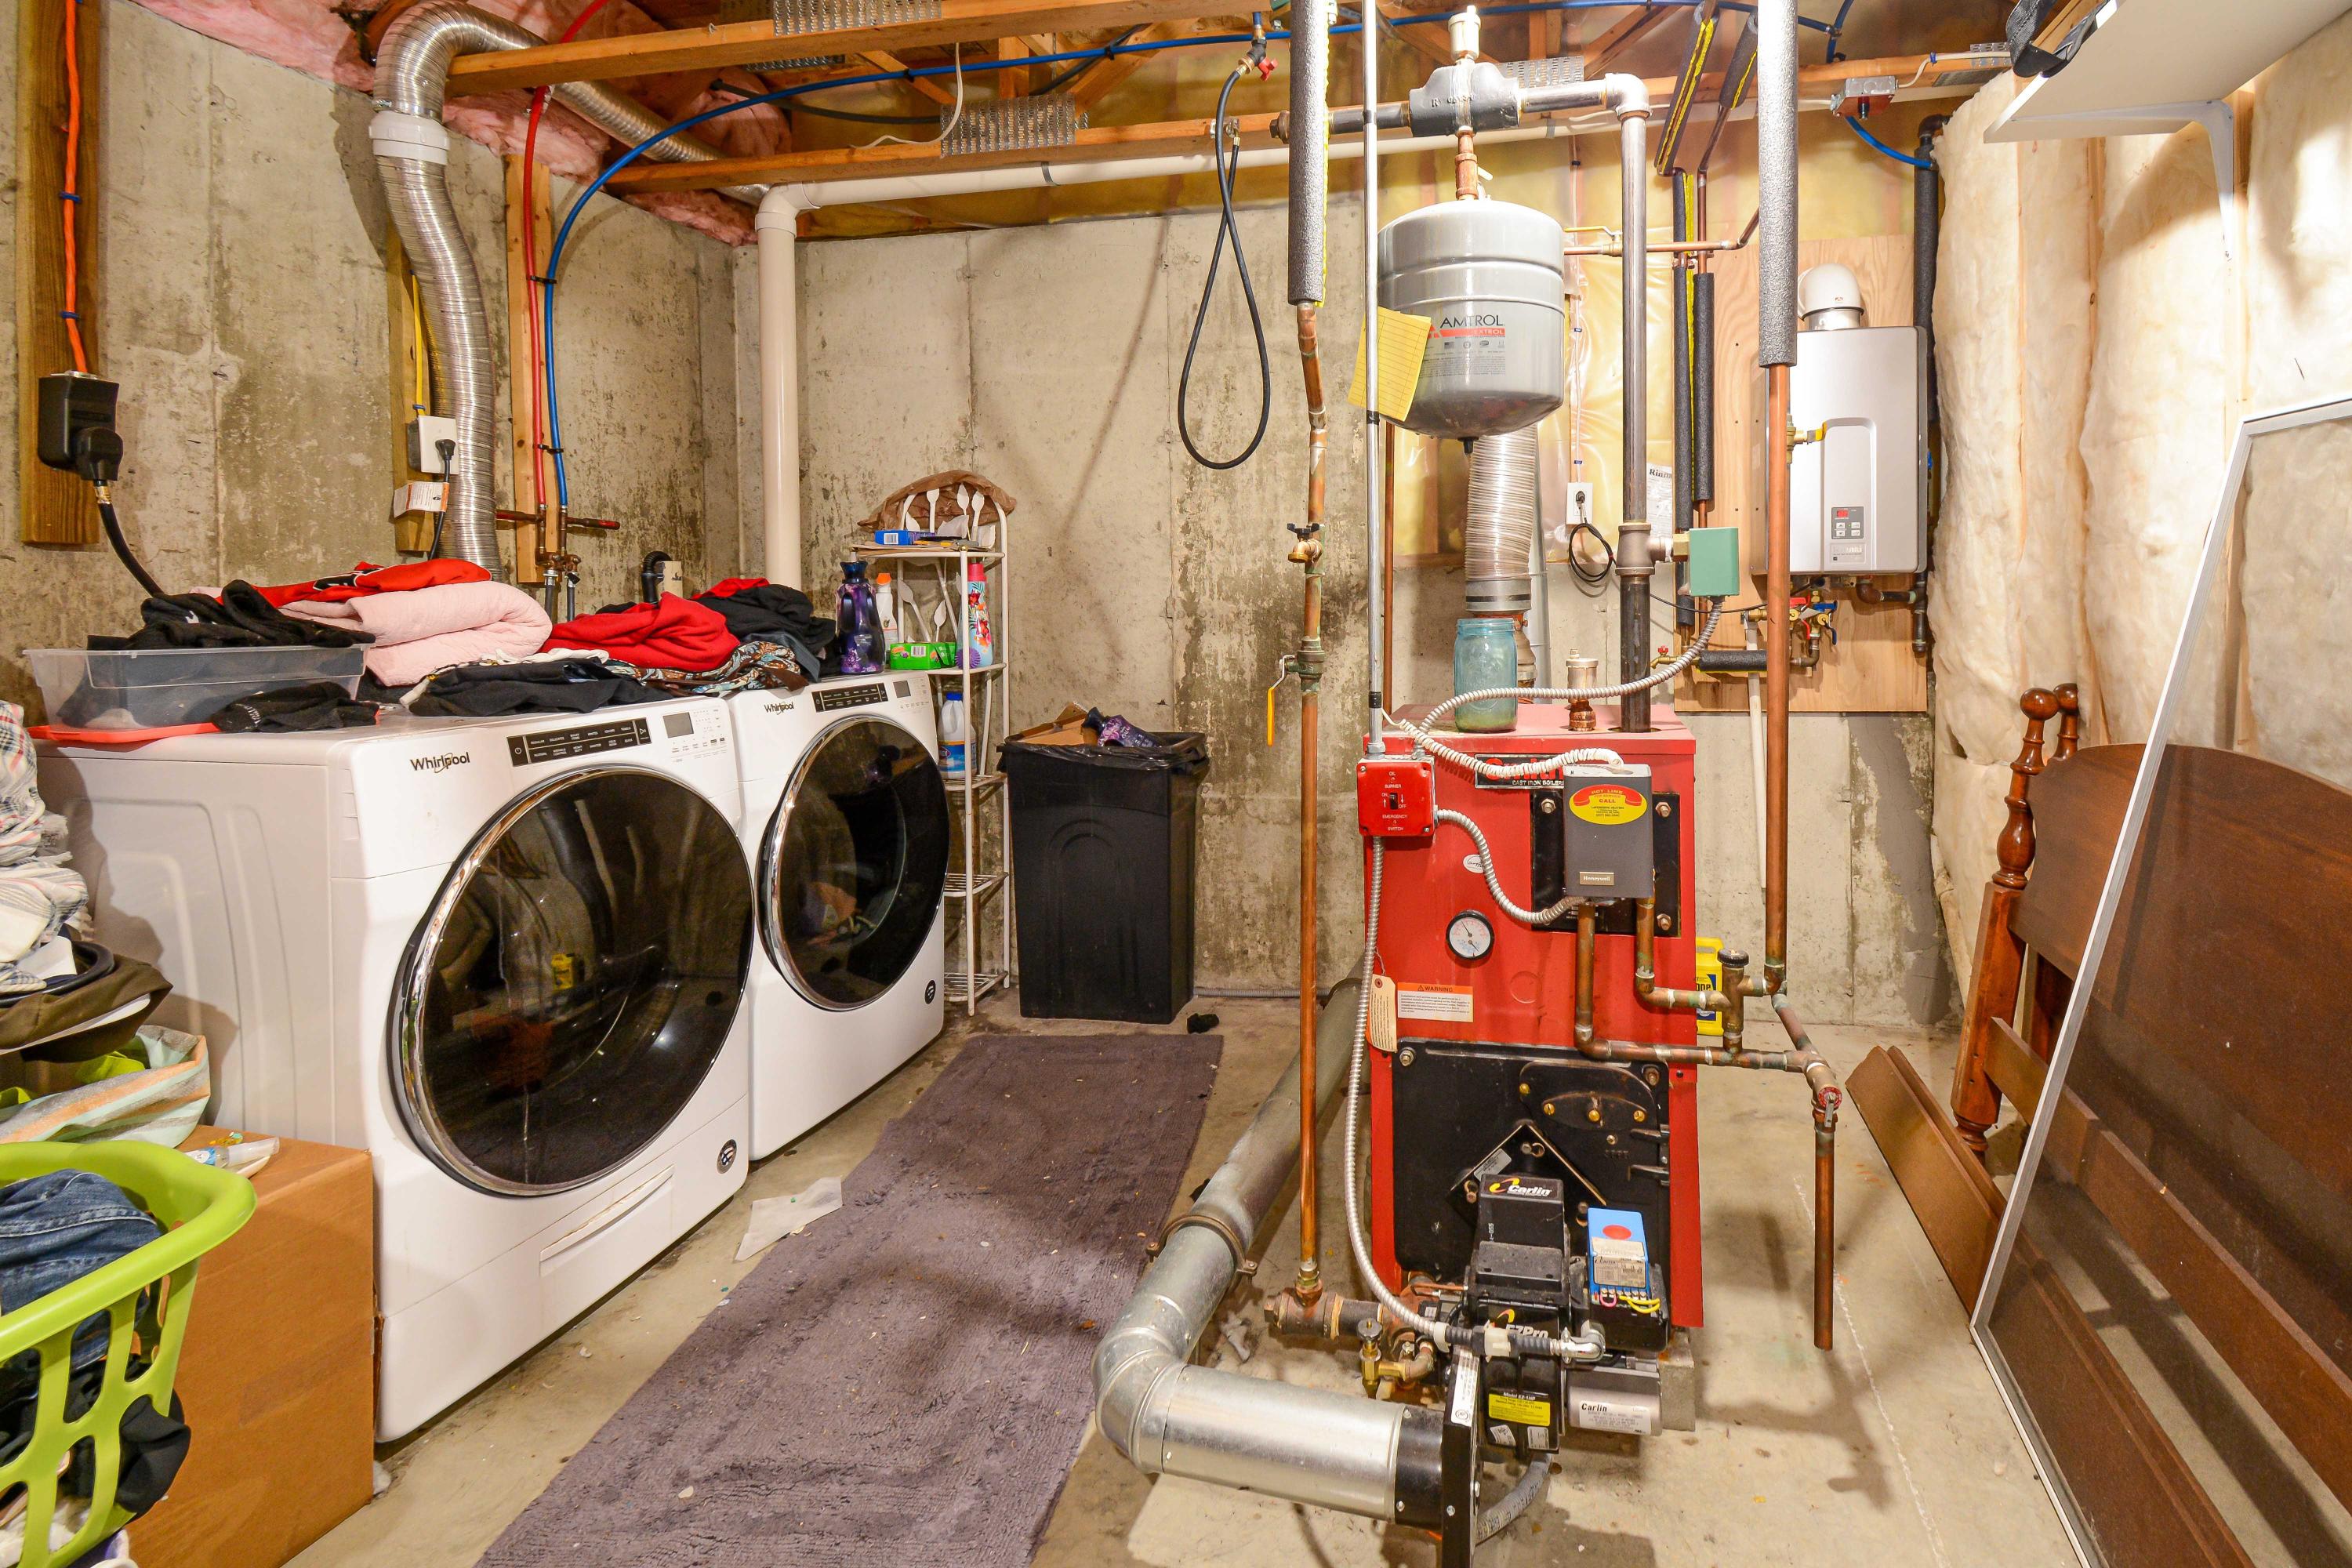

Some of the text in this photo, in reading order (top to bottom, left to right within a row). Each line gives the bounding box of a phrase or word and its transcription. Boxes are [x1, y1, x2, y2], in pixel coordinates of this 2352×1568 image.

[1439, 314, 1504, 328] AMTROL
[1649, 468, 1673, 479] Rinn
[764, 701, 794, 714] Whirlpool
[409, 752, 470, 773] Whirlpool
[1507, 1185, 1552, 1196] Carlin
[1581, 1403, 1607, 1412] Carlin
